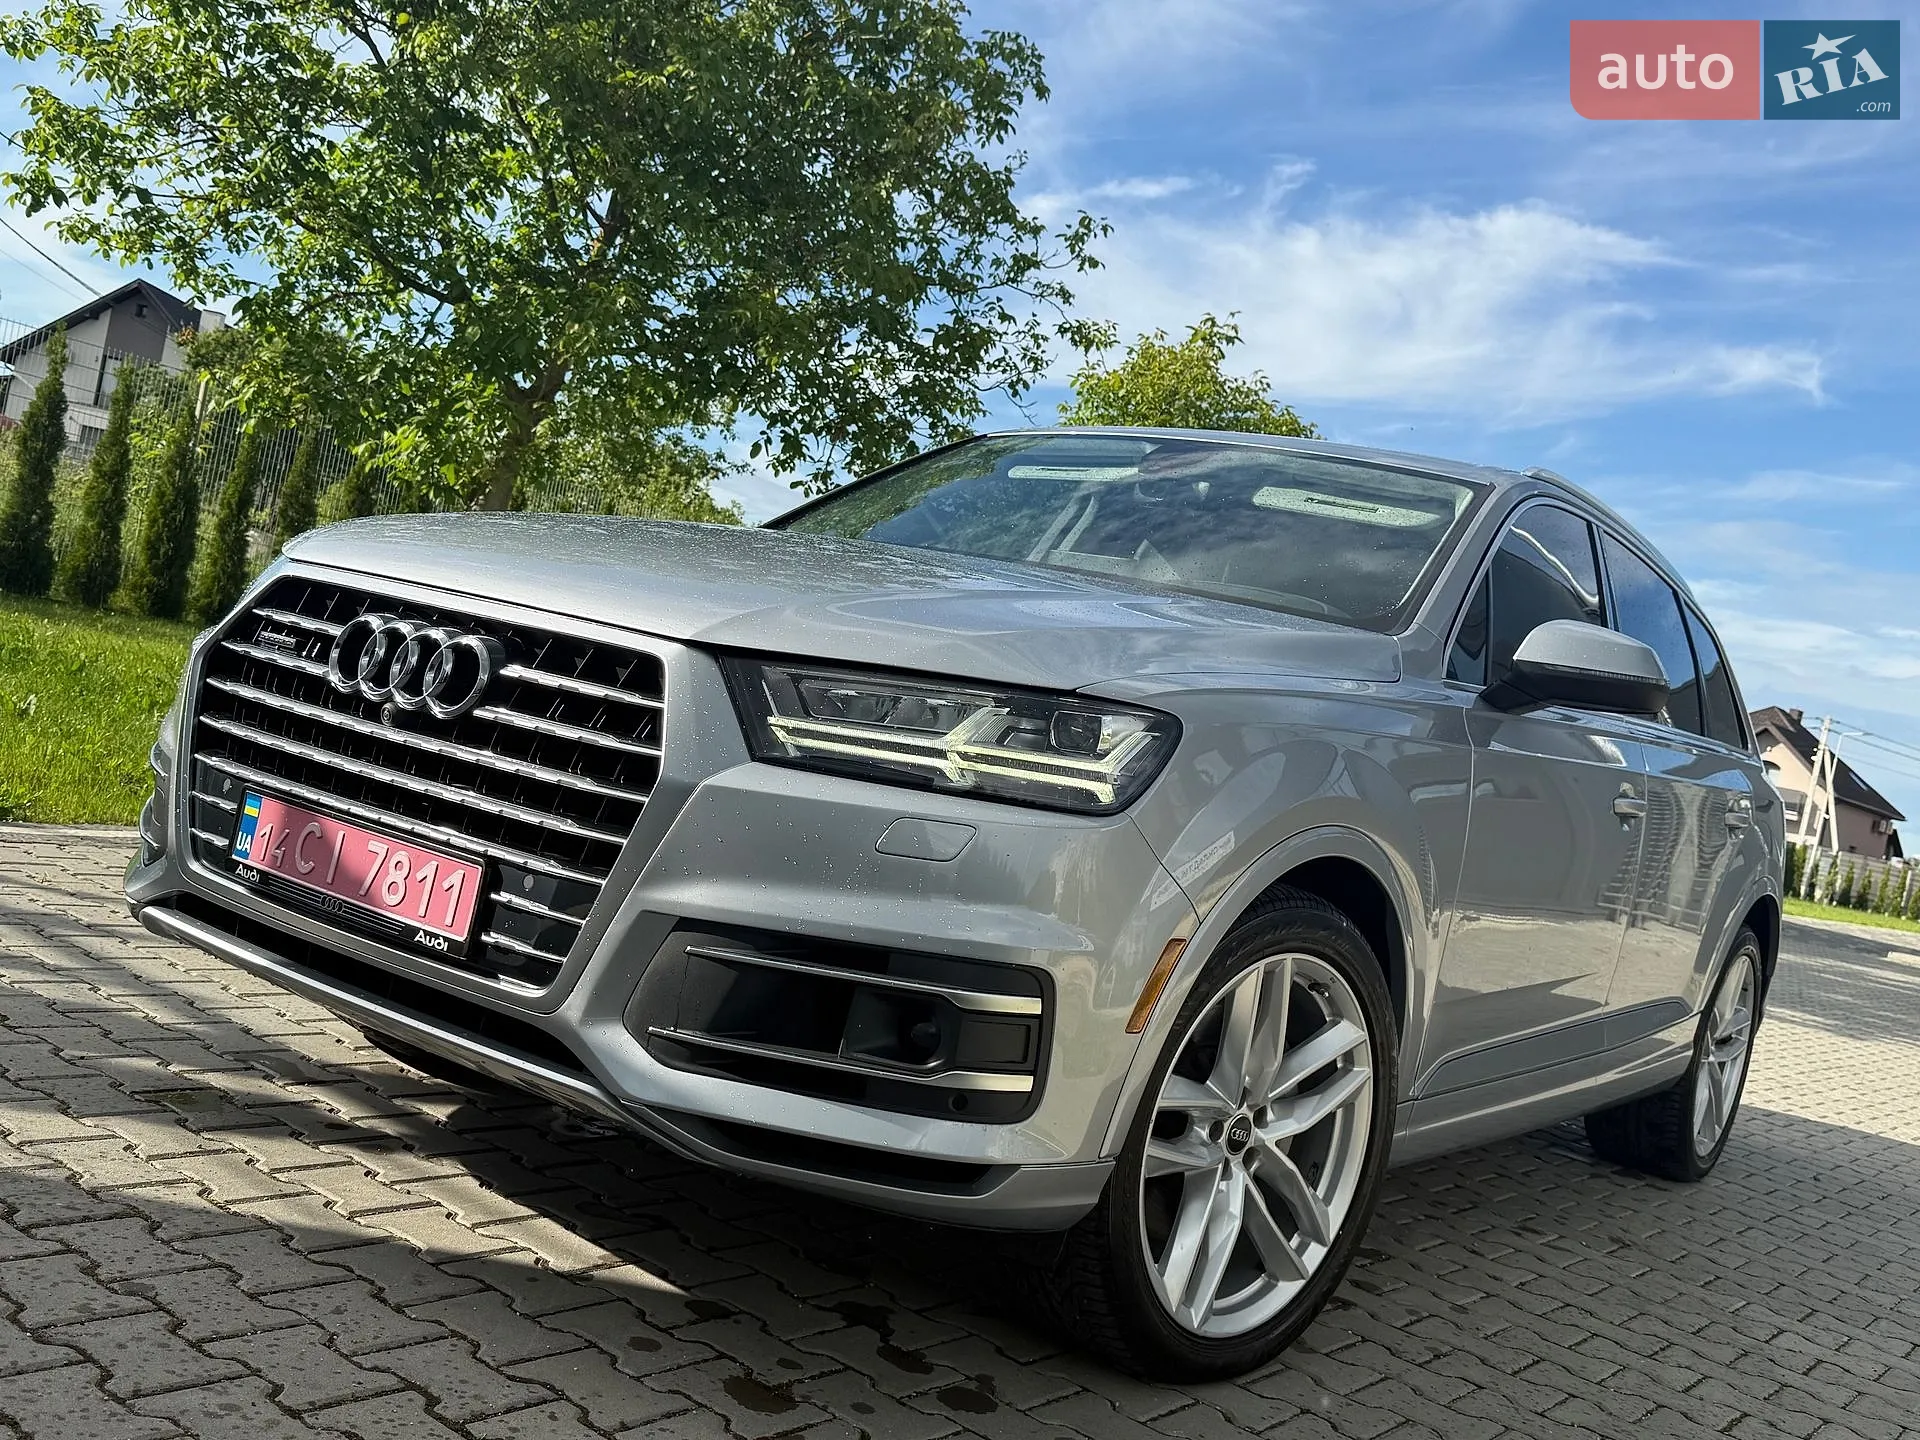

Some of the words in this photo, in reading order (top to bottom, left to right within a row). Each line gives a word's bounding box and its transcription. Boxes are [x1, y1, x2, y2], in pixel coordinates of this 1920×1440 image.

[236, 831, 251, 852] UA
[235, 863, 260, 883] Audi
[259, 822, 290, 868] 14
[359, 840, 466, 928] 7811
[414, 930, 449, 952] Audi
